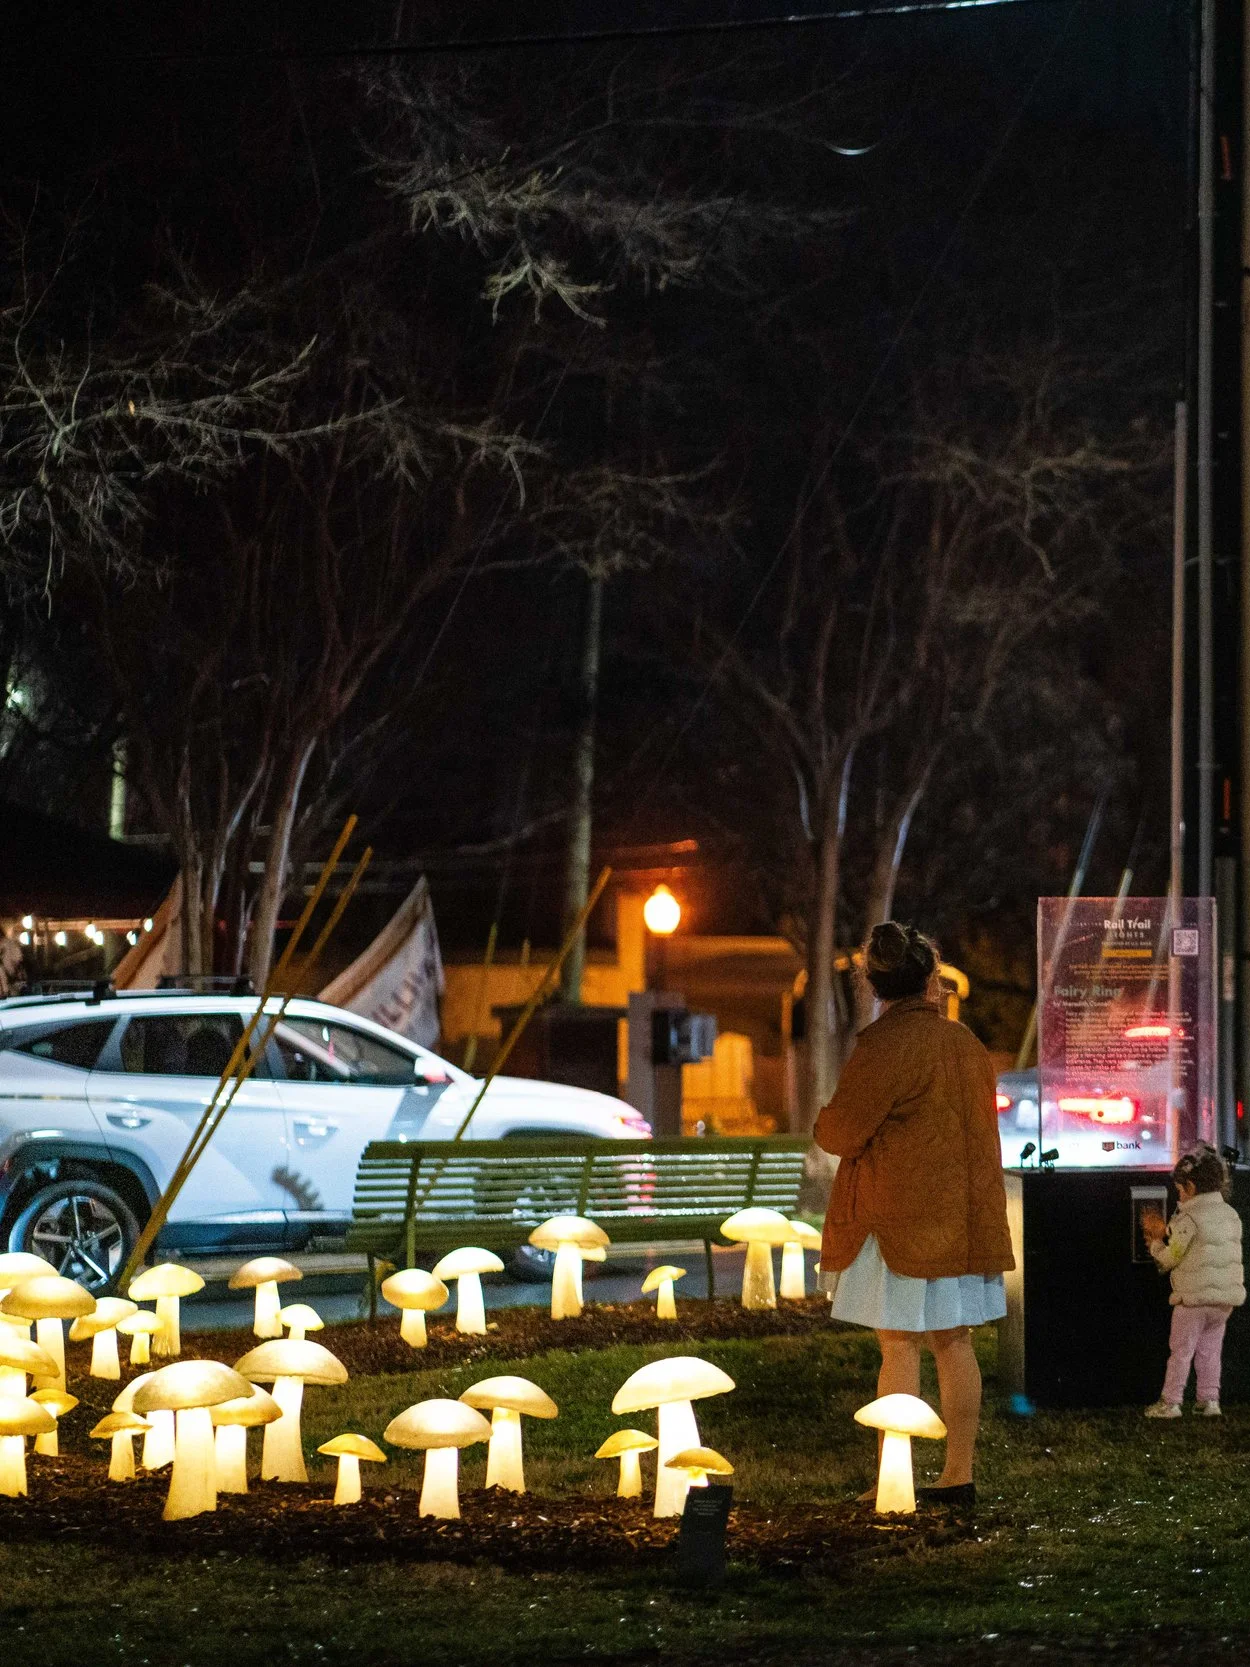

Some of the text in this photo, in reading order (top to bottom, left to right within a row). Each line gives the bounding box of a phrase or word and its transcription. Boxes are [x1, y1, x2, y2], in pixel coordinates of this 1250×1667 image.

[1103, 917, 1151, 929] Rail Trail
[1054, 985, 1088, 1000] Fairy
[1116, 1140, 1142, 1149] bank
